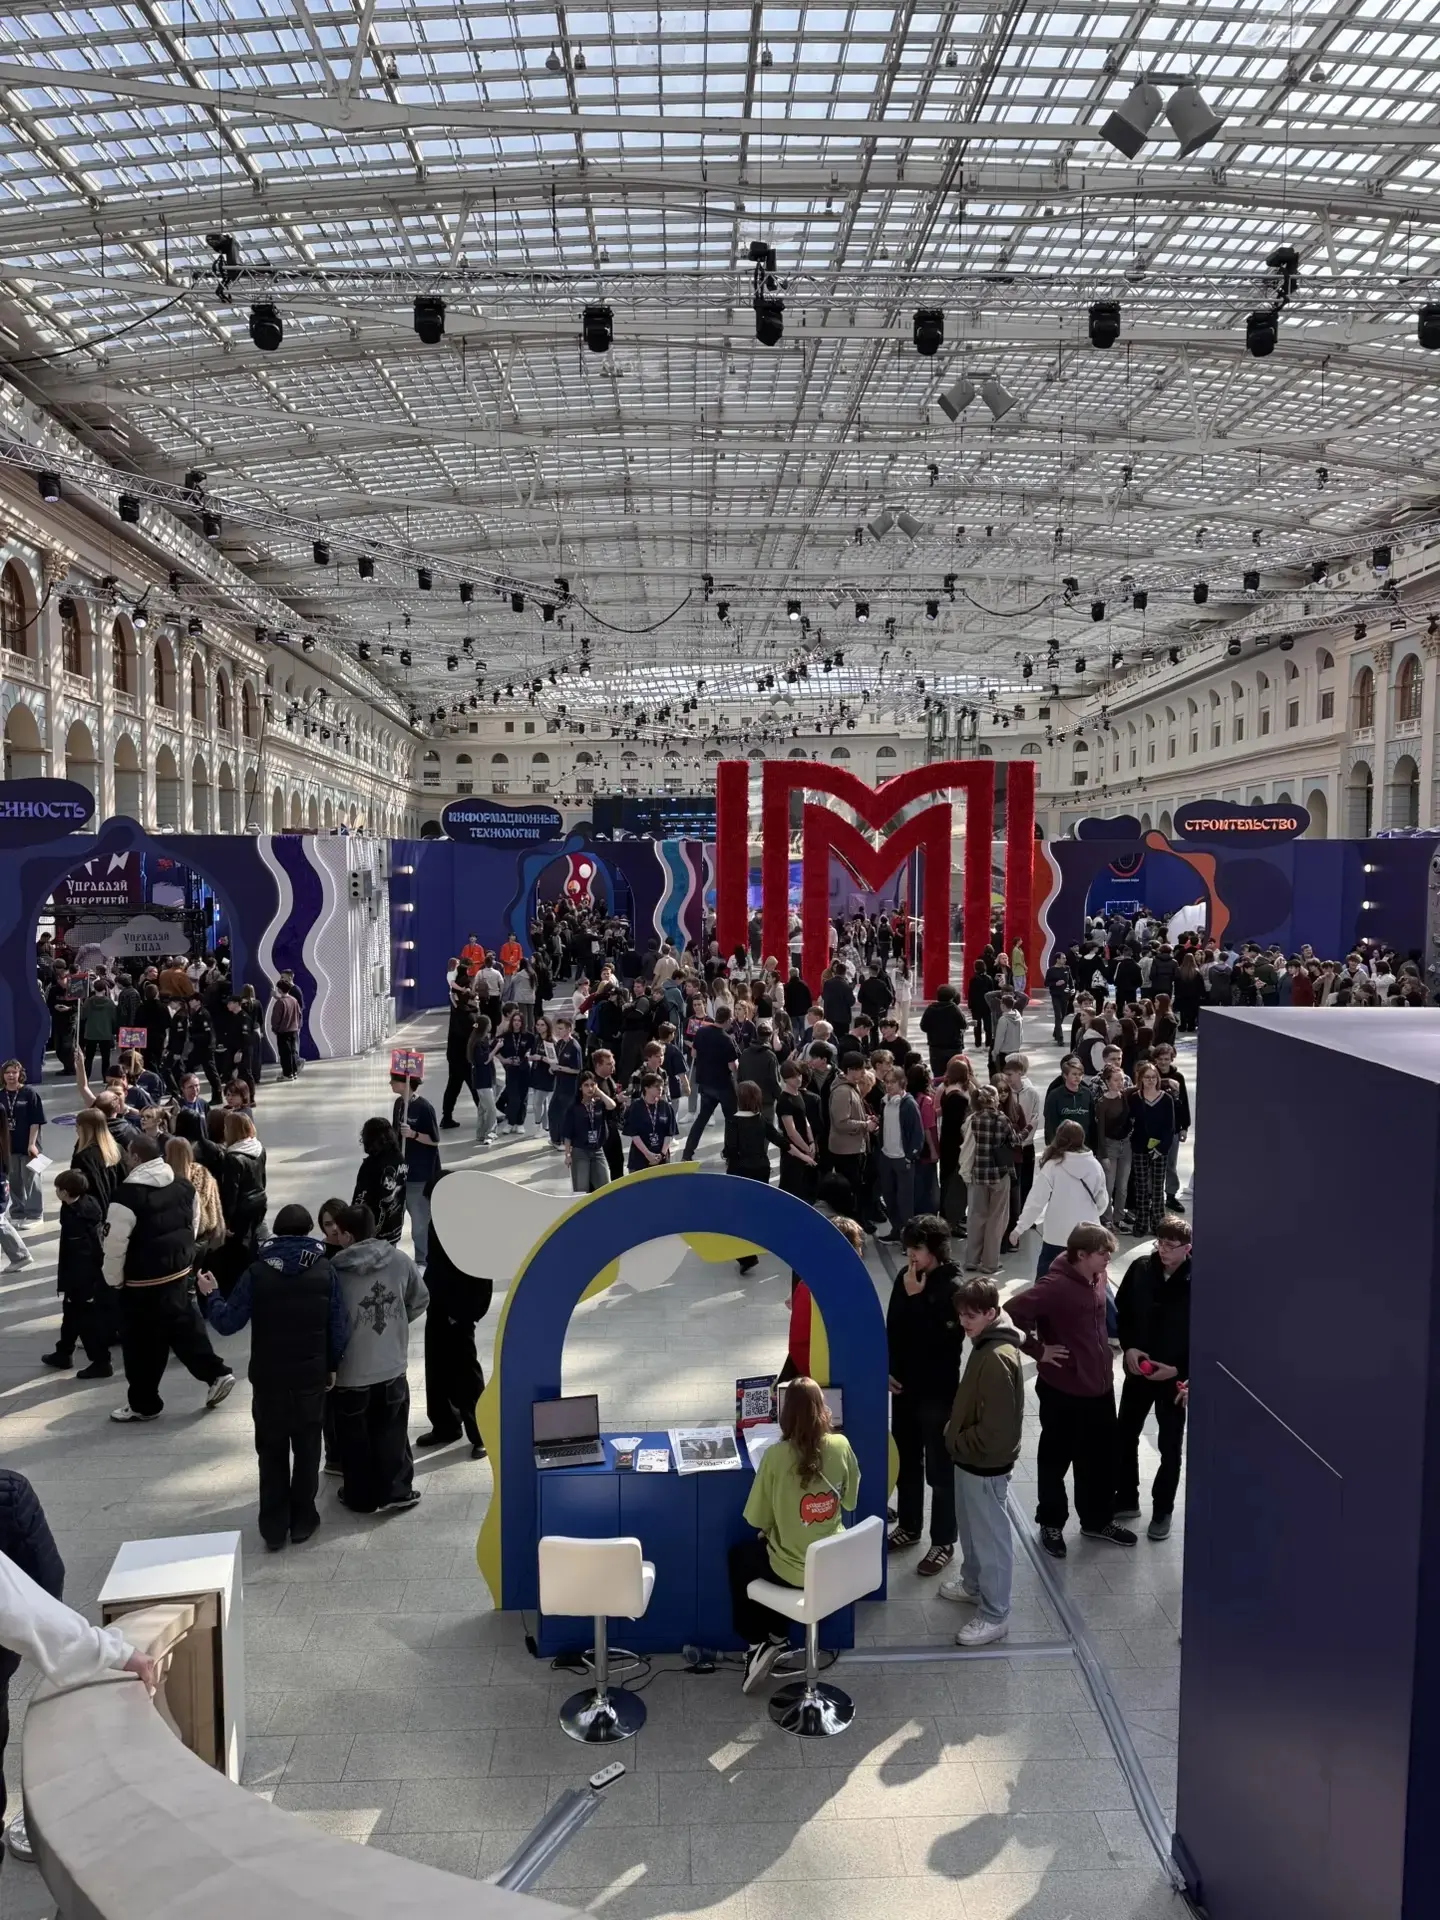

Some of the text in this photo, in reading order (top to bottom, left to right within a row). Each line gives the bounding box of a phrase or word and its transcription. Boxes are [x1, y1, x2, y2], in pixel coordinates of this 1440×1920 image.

[448, 812, 560, 826] ИНФОРМАЦИОННЫЕ
[1184, 818, 1297, 831] СТРОИТЕЛЬСТВО
[469, 828, 540, 839] ТЕХНОЛОГИИ
